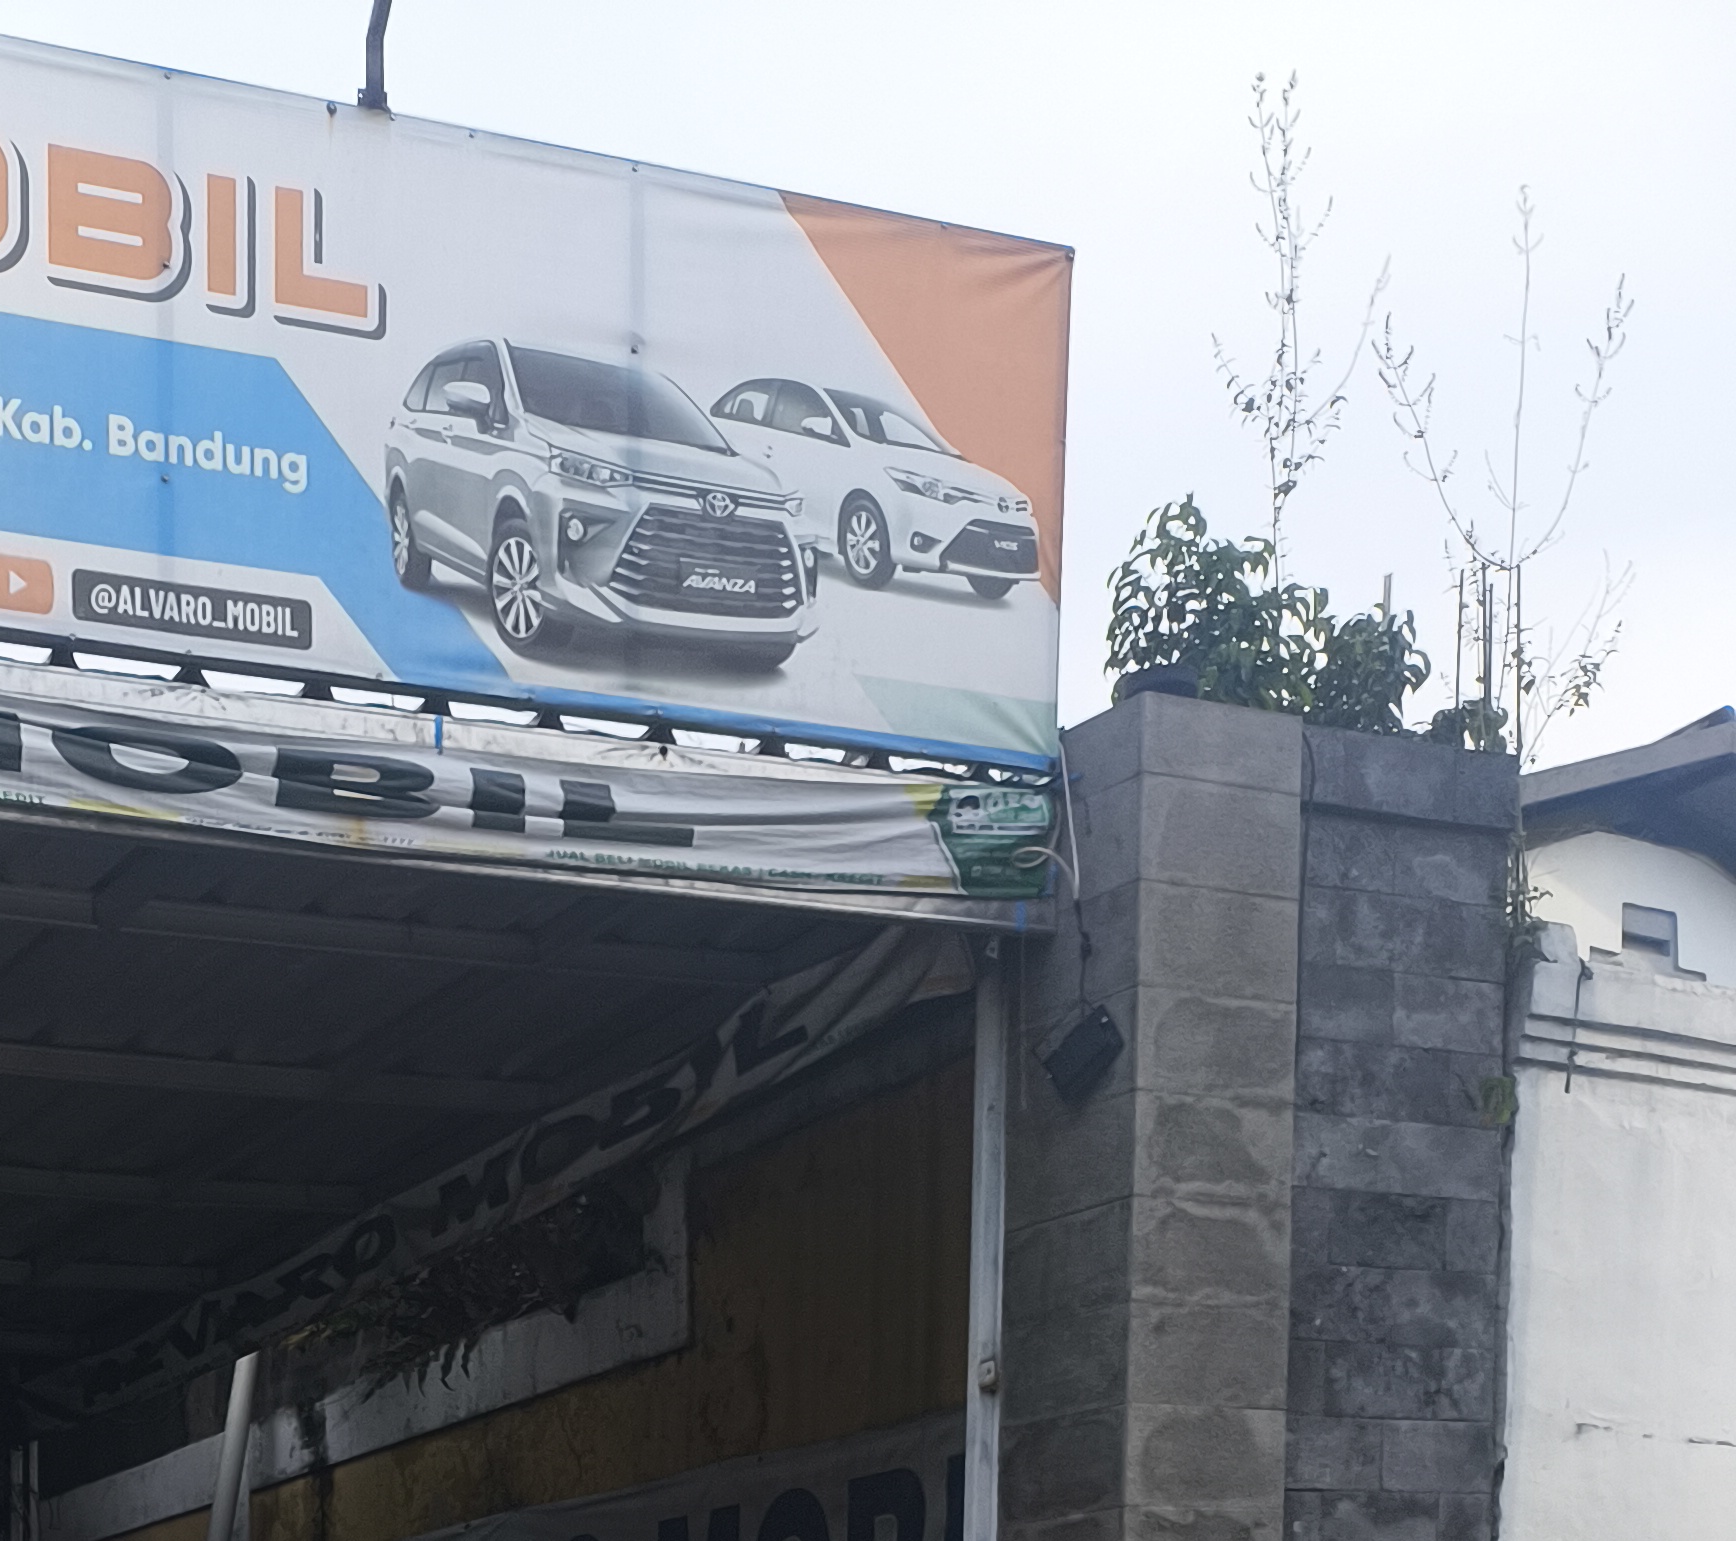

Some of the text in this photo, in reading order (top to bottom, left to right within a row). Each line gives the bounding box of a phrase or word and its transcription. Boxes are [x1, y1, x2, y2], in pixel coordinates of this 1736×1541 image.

[107, 414, 310, 494] Bandung
[89, 582, 300, 640] @ALVARO_MOBIL
[682, 573, 756, 595] AVANZA
